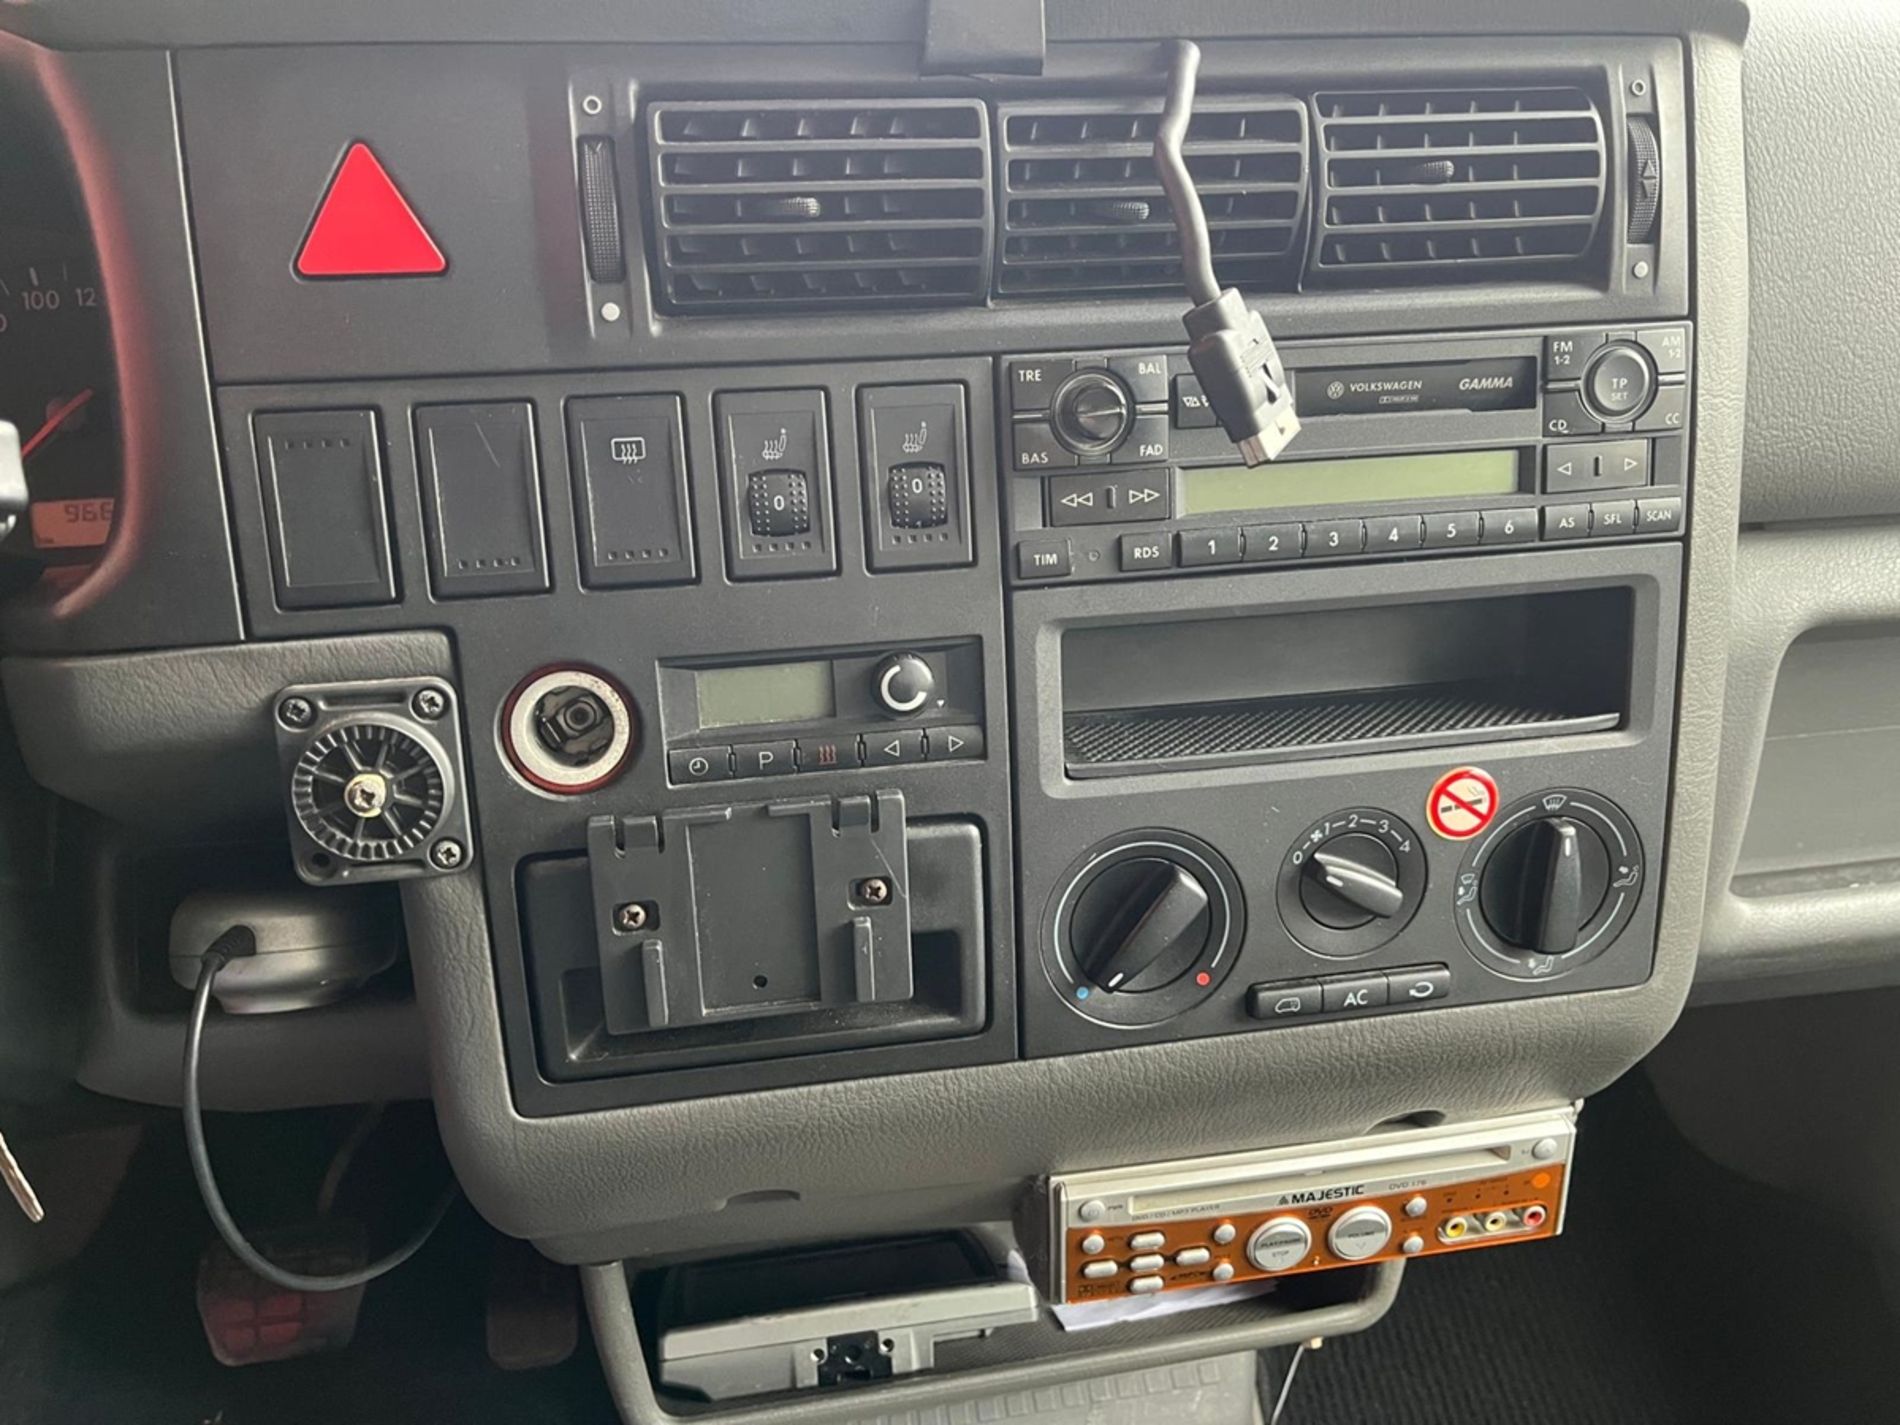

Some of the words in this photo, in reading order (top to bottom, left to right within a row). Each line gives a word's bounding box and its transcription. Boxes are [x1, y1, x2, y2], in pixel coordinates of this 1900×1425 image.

[21, 290, 60, 310] 100
[1553, 341, 1573, 352] FM
[1662, 336, 1681, 347] AM
[1668, 349, 1681, 359] 1-2
[1554, 356, 1571, 365] 1-2
[1138, 362, 1161, 375] BAL
[1018, 370, 1042, 382] TRE
[1350, 380, 1422, 392] VOLKSWAGEN
[1459, 376, 1513, 390] GAMMA
[1612, 378, 1628, 389] TP
[1665, 413, 1680, 424] CC
[1139, 444, 1163, 456] FAD
[1021, 452, 1049, 464] BAS
[1604, 514, 1622, 525] SFL
[1646, 510, 1672, 522] SCAN
[1504, 520, 1514, 534] 6
[1559, 518, 1575, 529] AS
[1388, 527, 1399, 541] 4
[1447, 524, 1456, 537] 5
[1268, 536, 1279, 550] 2
[1329, 531, 1339, 546] 3
[1134, 547, 1159, 558] RDS
[1208, 540, 1216, 555] 1
[1034, 554, 1058, 565] TIM
[759, 752, 773, 769] P
[1293, 851, 1303, 864] 0
[1325, 822, 1331, 835] 1
[1348, 814, 1358, 828] 2
[1378, 819, 1389, 833] 3
[1399, 839, 1411, 853] 4
[1344, 989, 1368, 1007] AC
[1291, 1185, 1365, 1204] MAJESTIC
